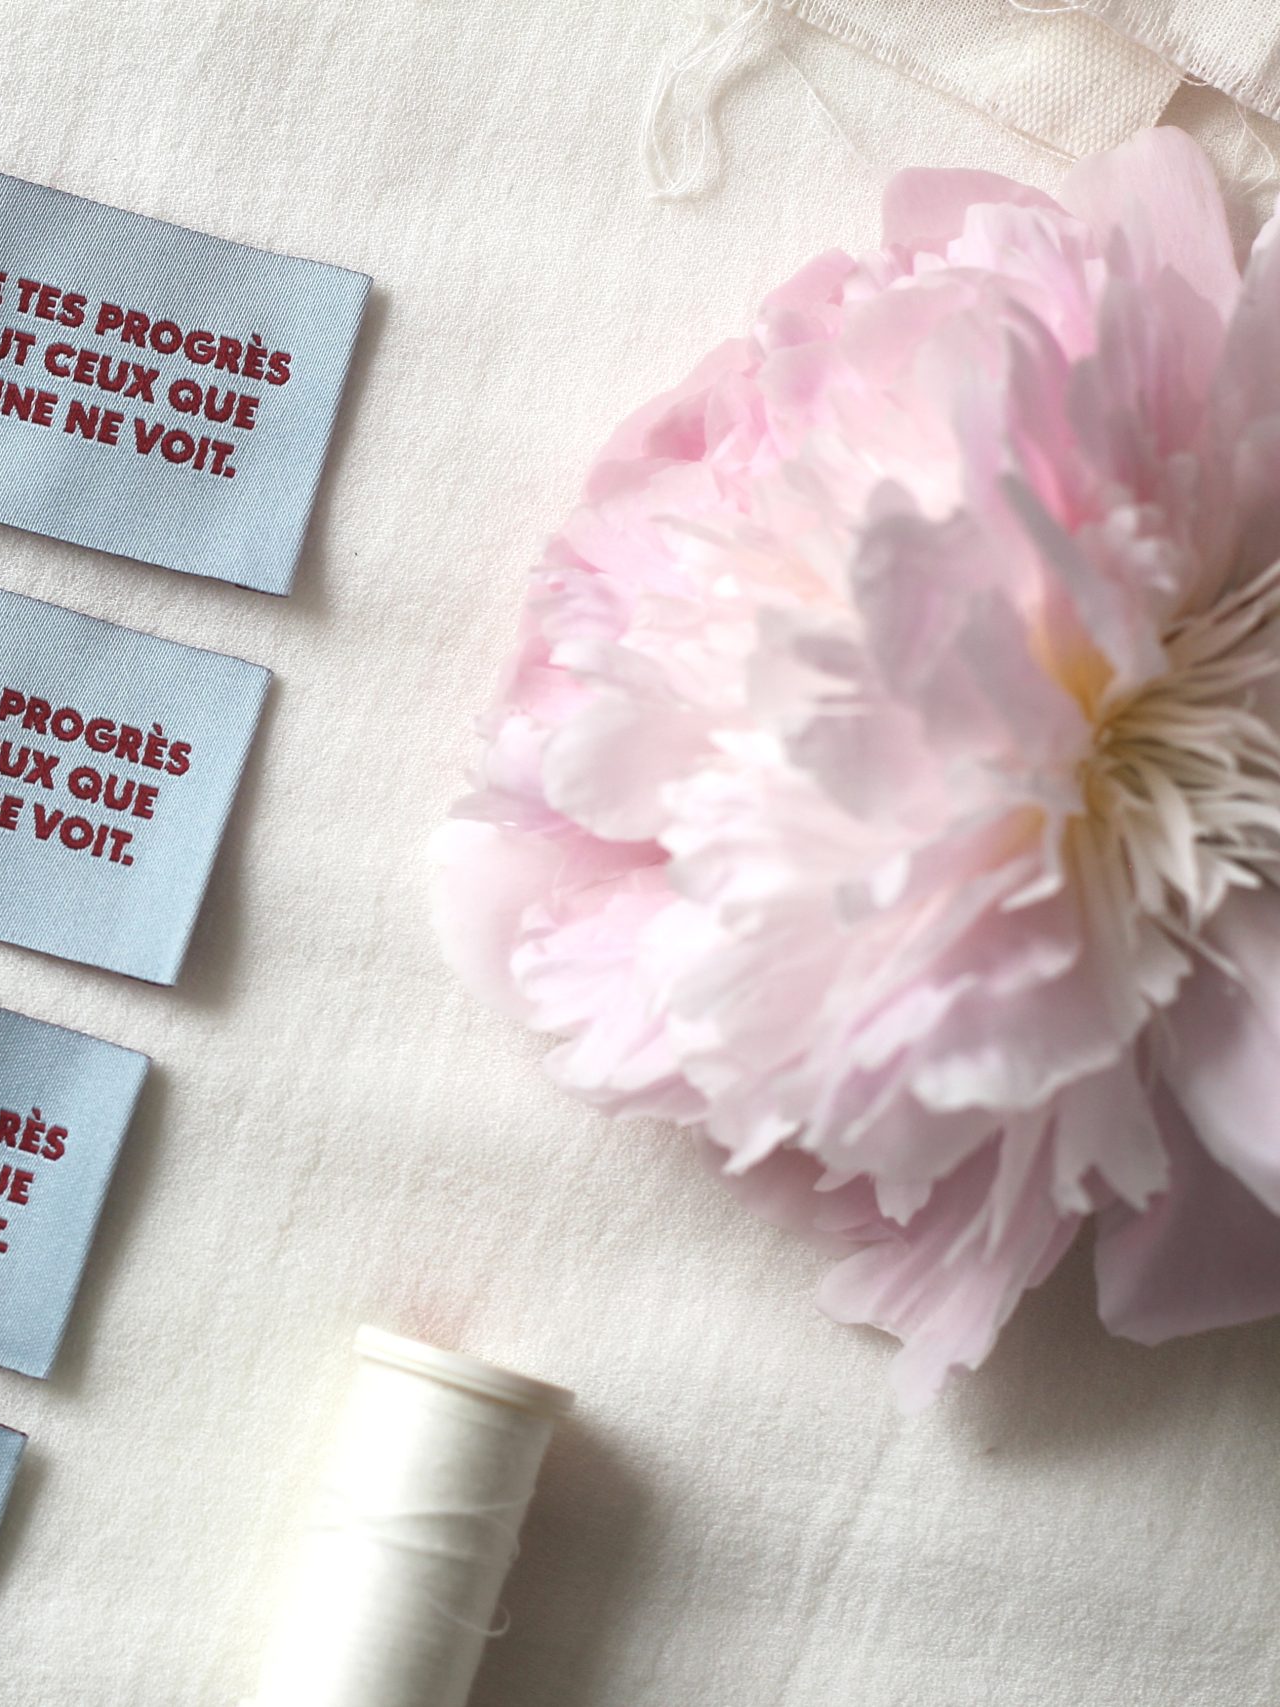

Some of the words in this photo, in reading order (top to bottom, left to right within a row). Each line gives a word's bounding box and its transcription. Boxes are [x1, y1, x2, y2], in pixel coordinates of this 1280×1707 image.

[16, 278, 84, 326] TES
[93, 303, 289, 384] PROGRÈS
[43, 343, 158, 402] CEUX
[166, 379, 258, 429] QUE
[63, 400, 122, 444] NE
[133, 418, 233, 476] VOIT.
[66, 766, 157, 818] QUE
[32, 803, 131, 863] VOIT.
